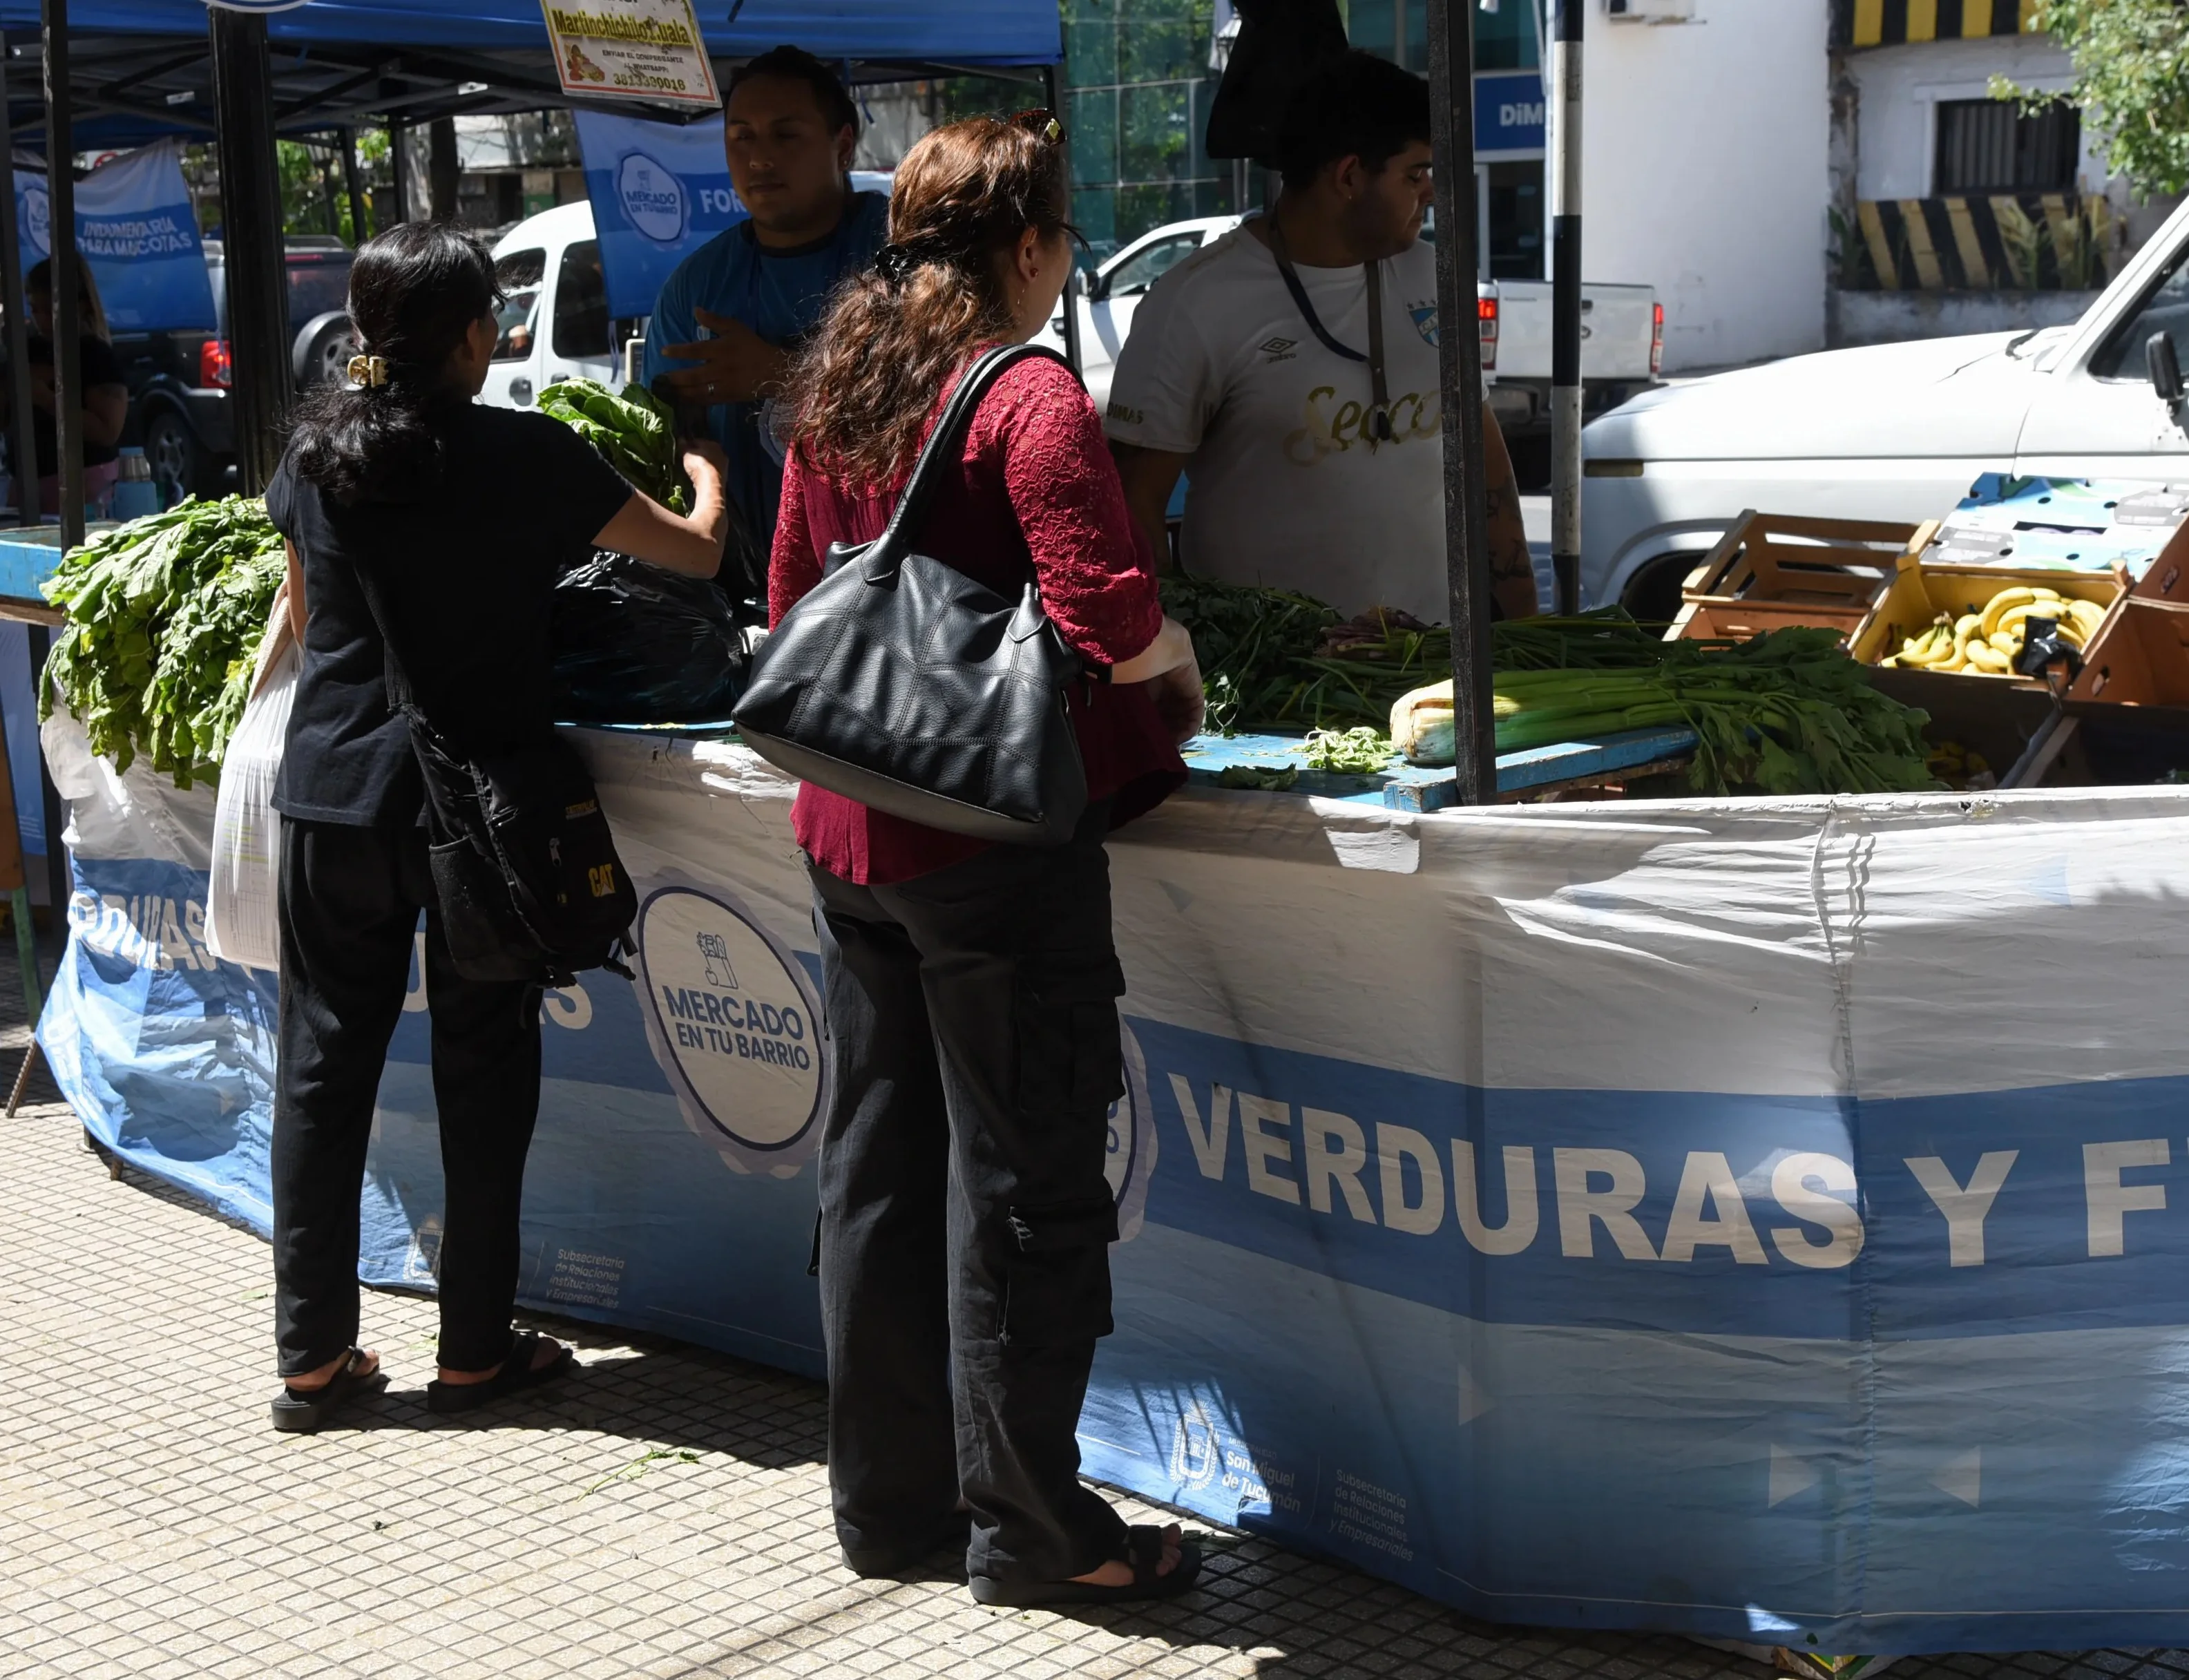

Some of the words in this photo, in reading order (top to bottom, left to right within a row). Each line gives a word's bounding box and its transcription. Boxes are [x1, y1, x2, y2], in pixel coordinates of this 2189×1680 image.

[626, 191, 677, 205] MERCADO
[589, 863, 615, 897] CAT
[662, 985, 804, 1041] MERCADO
[676, 1022, 705, 1050] EN
[705, 1027, 734, 1056] TU
[738, 1033, 810, 1071] BARRIO
[1167, 1071, 1866, 1270] VERDURAS
[1902, 1149, 2020, 1267] Y
[2082, 1138, 2189, 1257] F
[555, 1262, 567, 1272] de
[568, 1263, 620, 1281] Relaciones
[546, 1288, 553, 1299] y
[1226, 1449, 1250, 1473] San
[1253, 1459, 1294, 1489] Miguel
[1336, 1469, 1406, 1509] Subsecretaría
[1222, 1471, 1239, 1490] de
[1241, 1478, 1301, 1513] Tucumán
[1335, 1485, 1348, 1500] de
[1350, 1489, 1405, 1525] Relaciones
[1328, 1518, 1337, 1534] y
[1337, 1519, 1414, 1562] Empresariales
[1334, 1501, 1408, 1543] Institucionales
